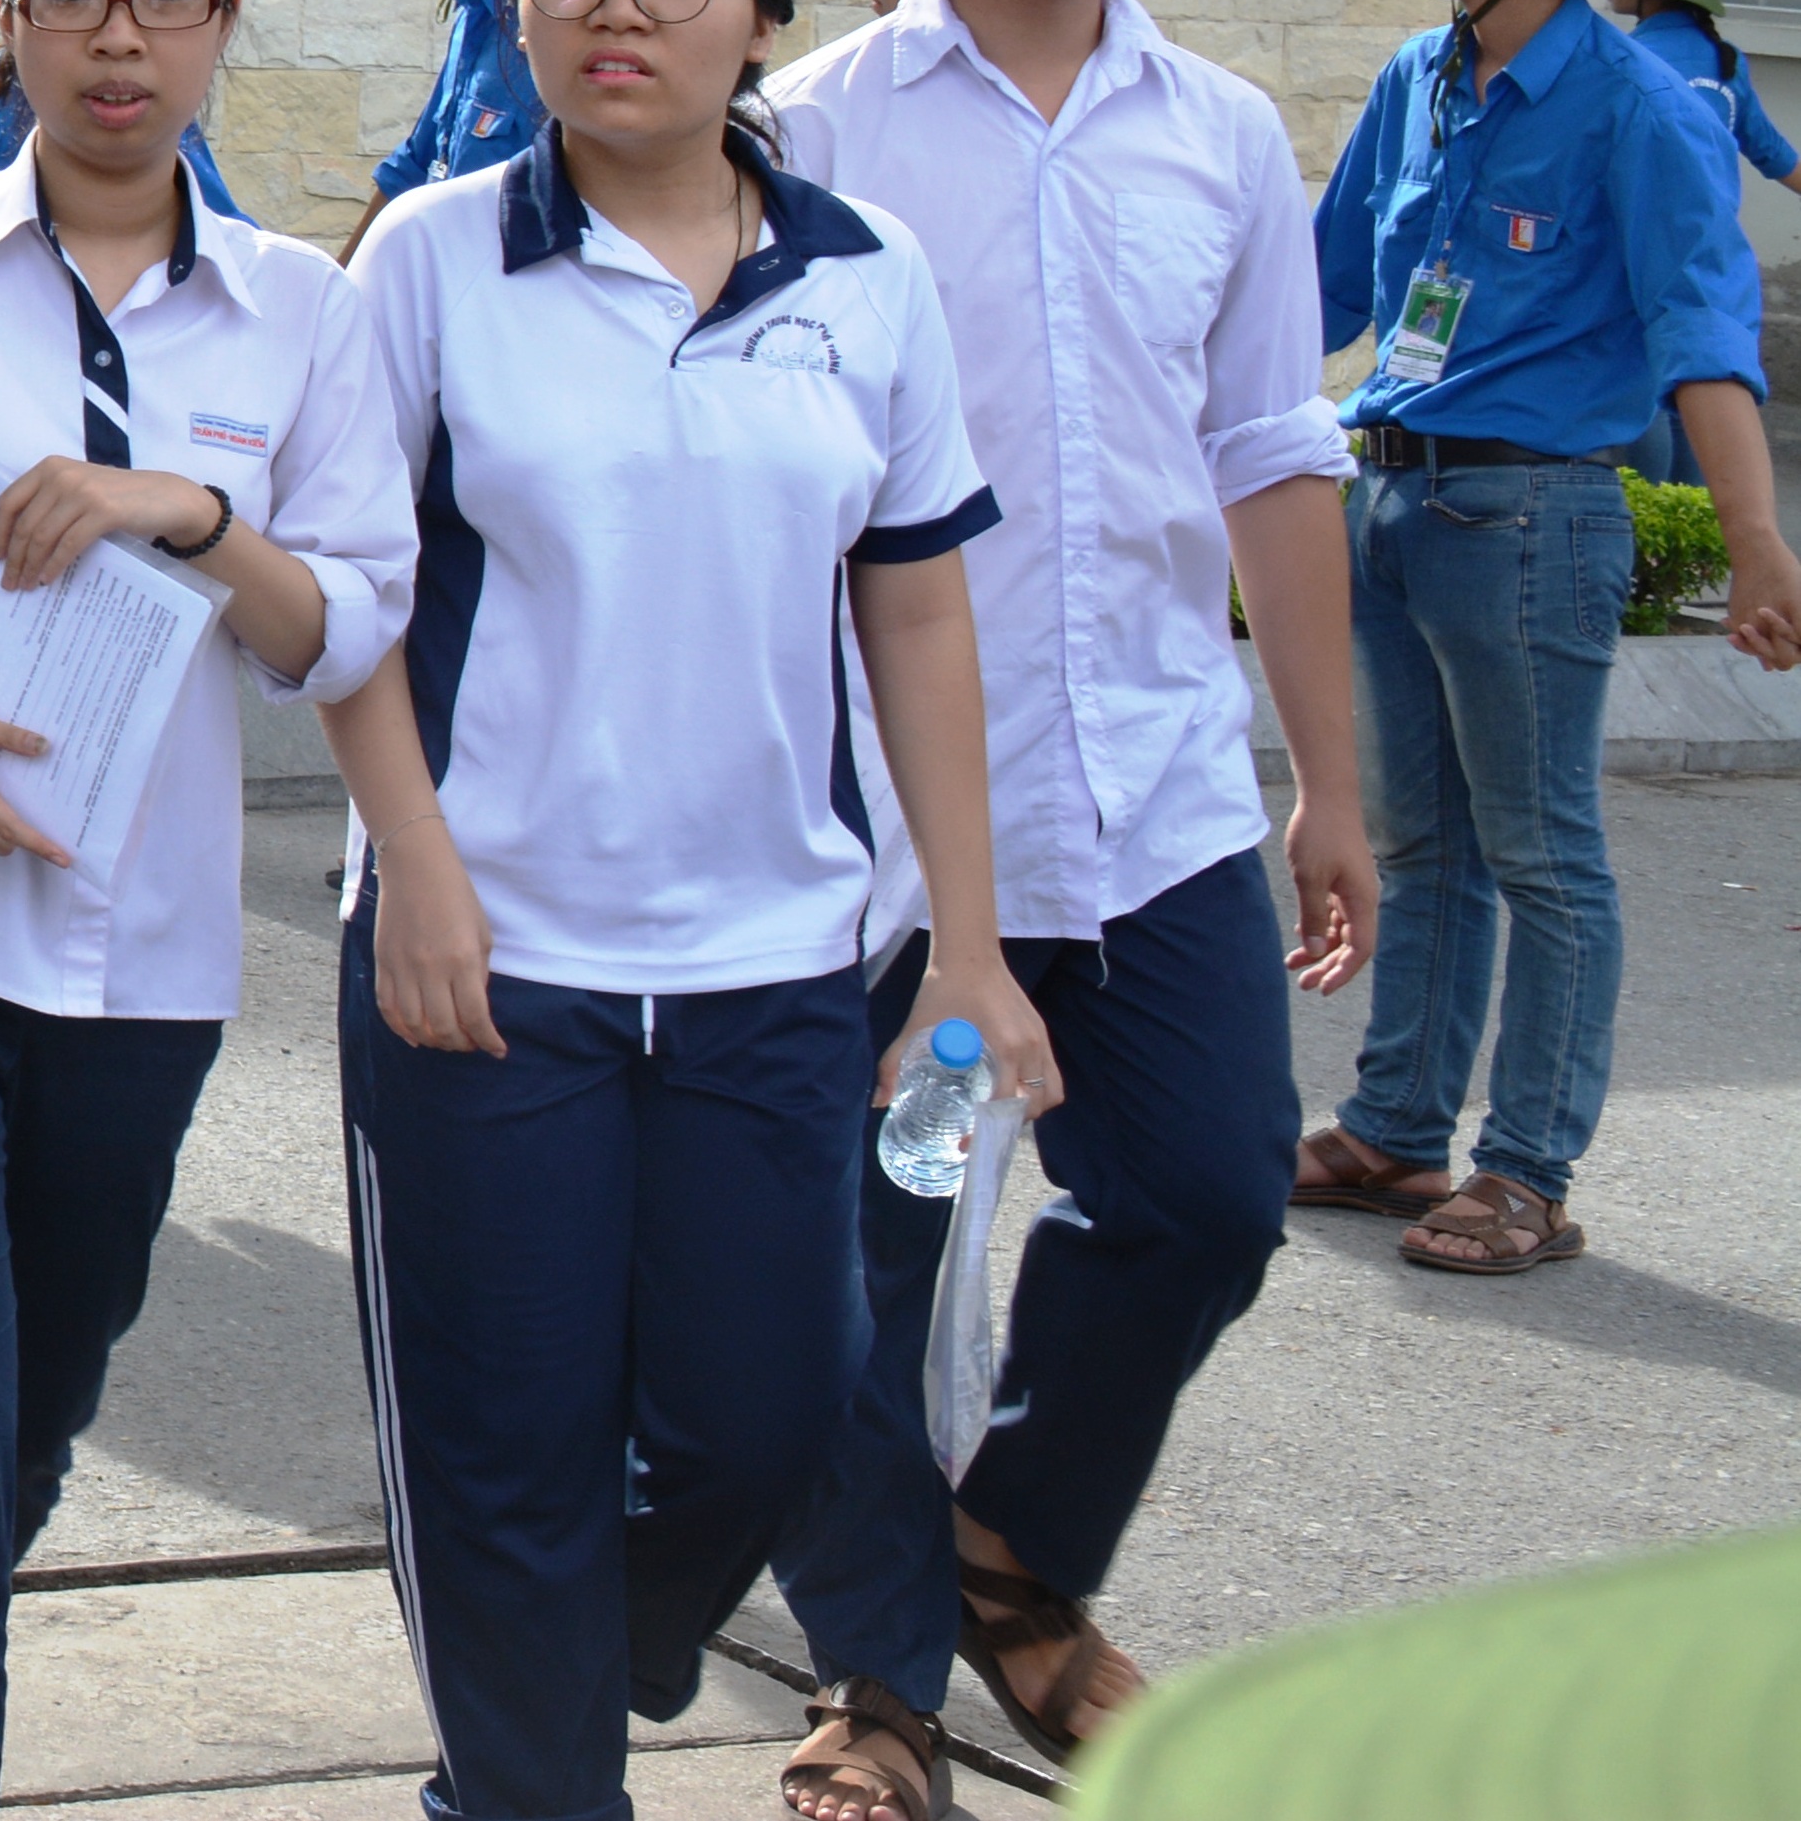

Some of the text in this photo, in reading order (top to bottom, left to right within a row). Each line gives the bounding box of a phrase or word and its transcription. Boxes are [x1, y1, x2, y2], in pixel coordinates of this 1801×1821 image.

[740, 315, 842, 375] TRƯỜNG TRUNG HỌC PHỔ THÔNG
